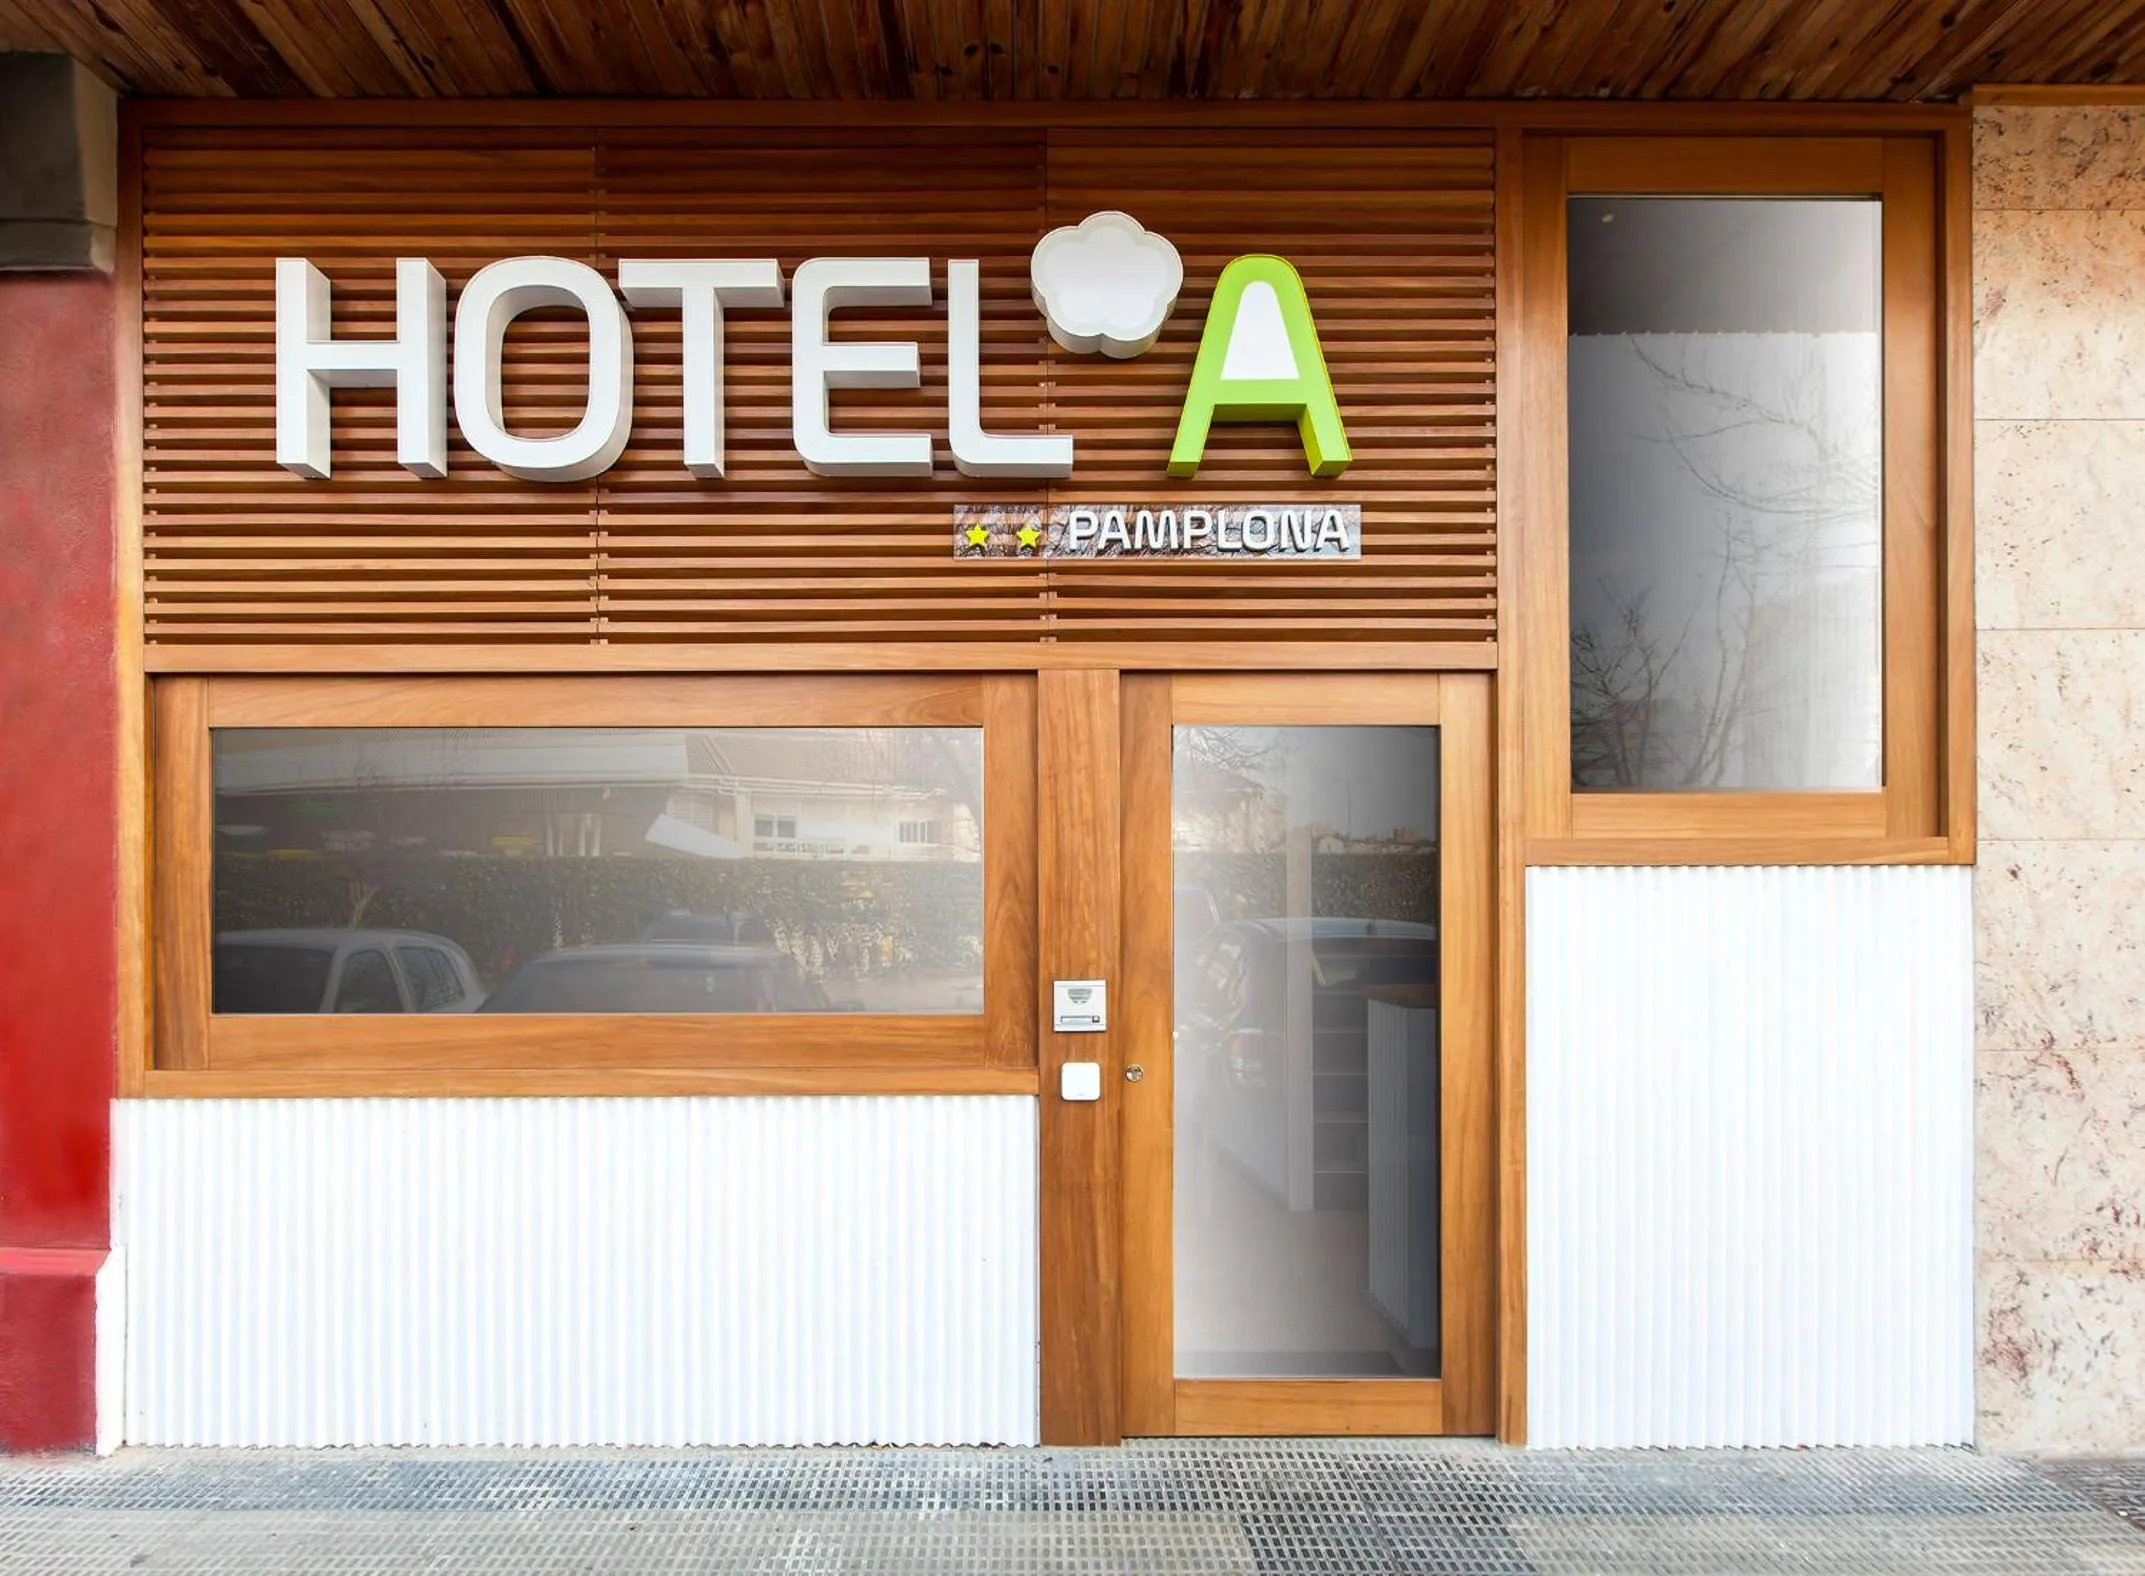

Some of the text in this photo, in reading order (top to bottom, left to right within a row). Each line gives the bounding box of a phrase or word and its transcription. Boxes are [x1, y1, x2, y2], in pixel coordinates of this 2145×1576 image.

[274, 253, 1353, 481] HOTEL A
[1068, 508, 1351, 553] PAMPLONA
